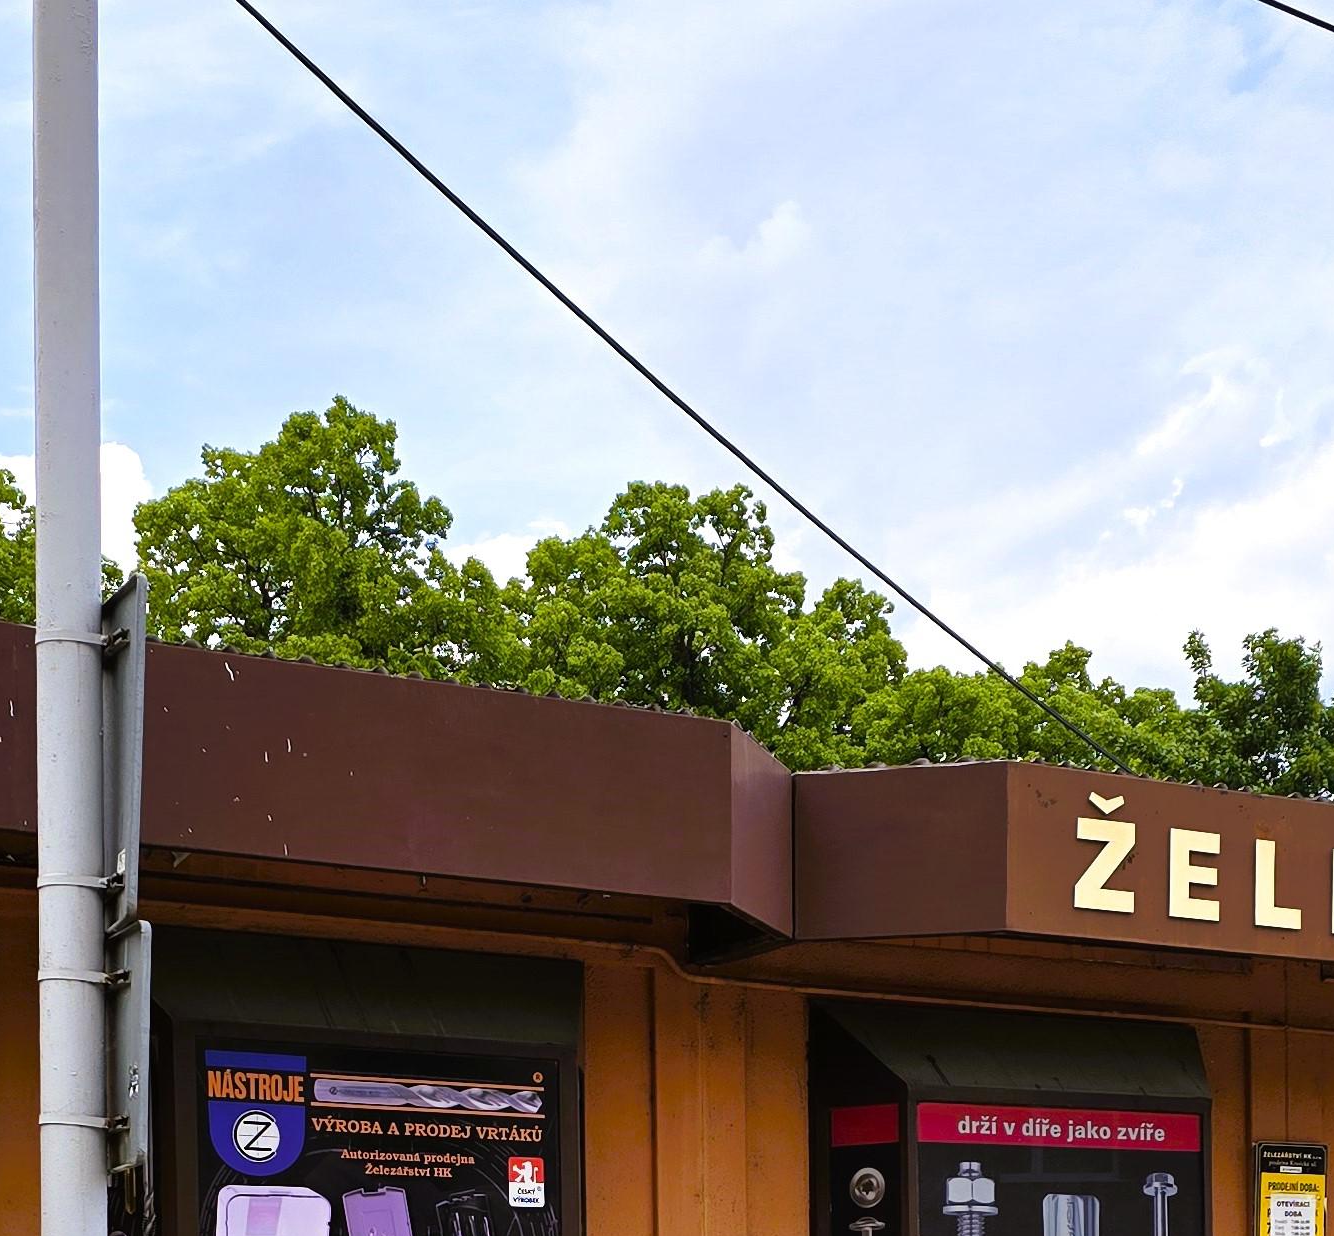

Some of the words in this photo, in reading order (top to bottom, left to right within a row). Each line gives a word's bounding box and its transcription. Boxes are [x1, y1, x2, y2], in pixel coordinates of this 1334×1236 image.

[207, 1069, 305, 1103] NÁSTROJE
[311, 1115, 384, 1136] VÝROBA
[388, 1124, 400, 1136] A
[404, 1122, 471, 1139] PRODEJ
[476, 1125, 543, 1143] VRTÁKŮ
[958, 1115, 997, 1135] drží
[1003, 1121, 1016, 1136] v
[1021, 1118, 1062, 1138] díře
[1067, 1119, 1111, 1142] jako
[1116, 1123, 1166, 1142] zvíře
[341, 1148, 420, 1163] Autorizovaná
[423, 1152, 475, 1166] prodejna
[365, 1163, 431, 1178] Železářství
[434, 1167, 452, 1178] HK
